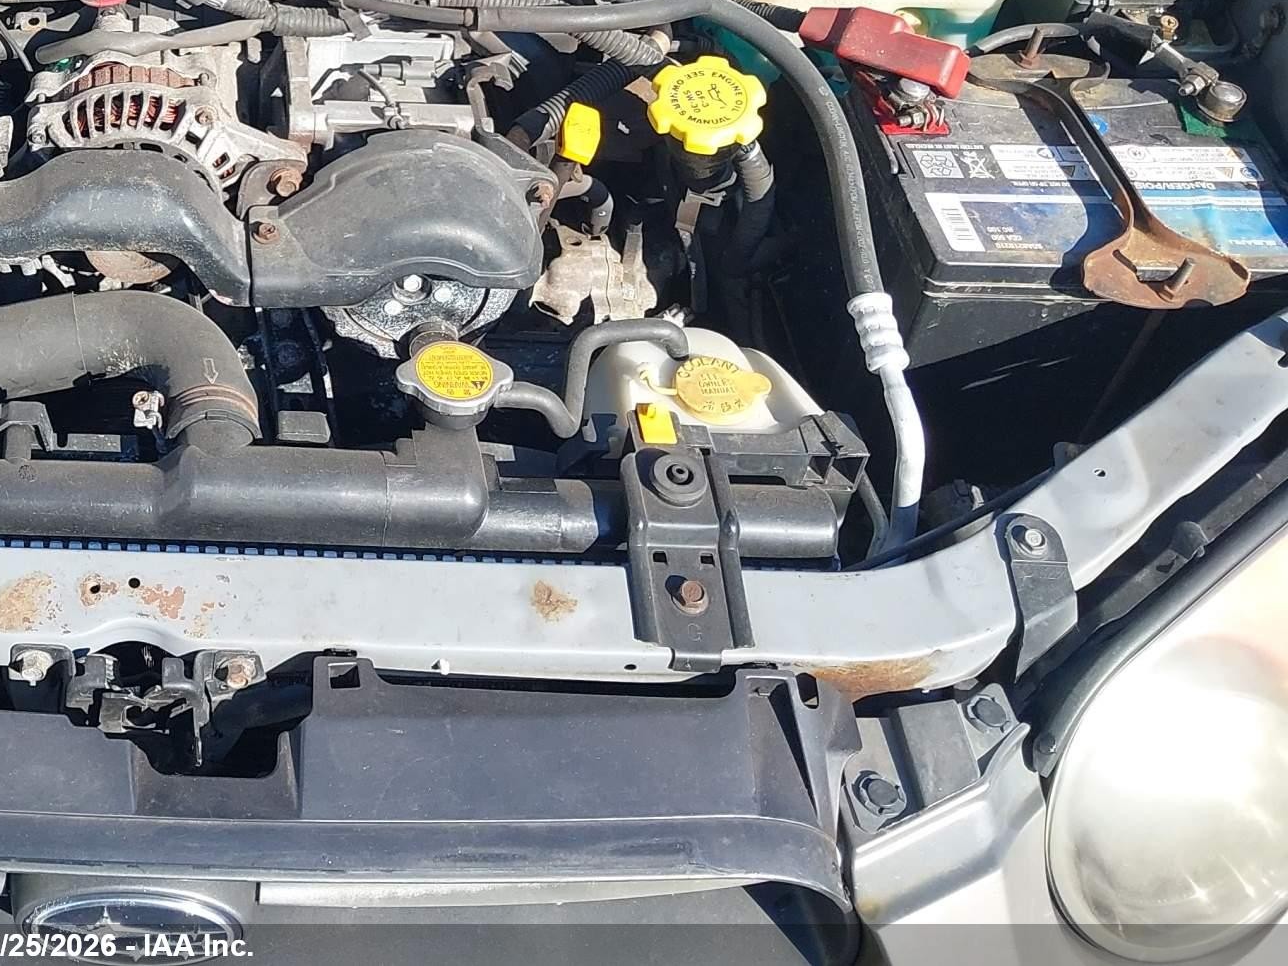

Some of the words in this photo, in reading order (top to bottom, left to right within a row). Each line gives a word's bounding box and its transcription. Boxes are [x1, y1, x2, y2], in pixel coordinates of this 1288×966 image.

[684, 70, 705, 80] SEE
[712, 71, 743, 96] ENGINE
[731, 99, 743, 112] OIL
[687, 115, 731, 124] MANUAL
[1133, 181, 1217, 190] DANGER/POIS
[677, 357, 739, 378] COOLANT
[701, 387, 736, 395] MANUAL
